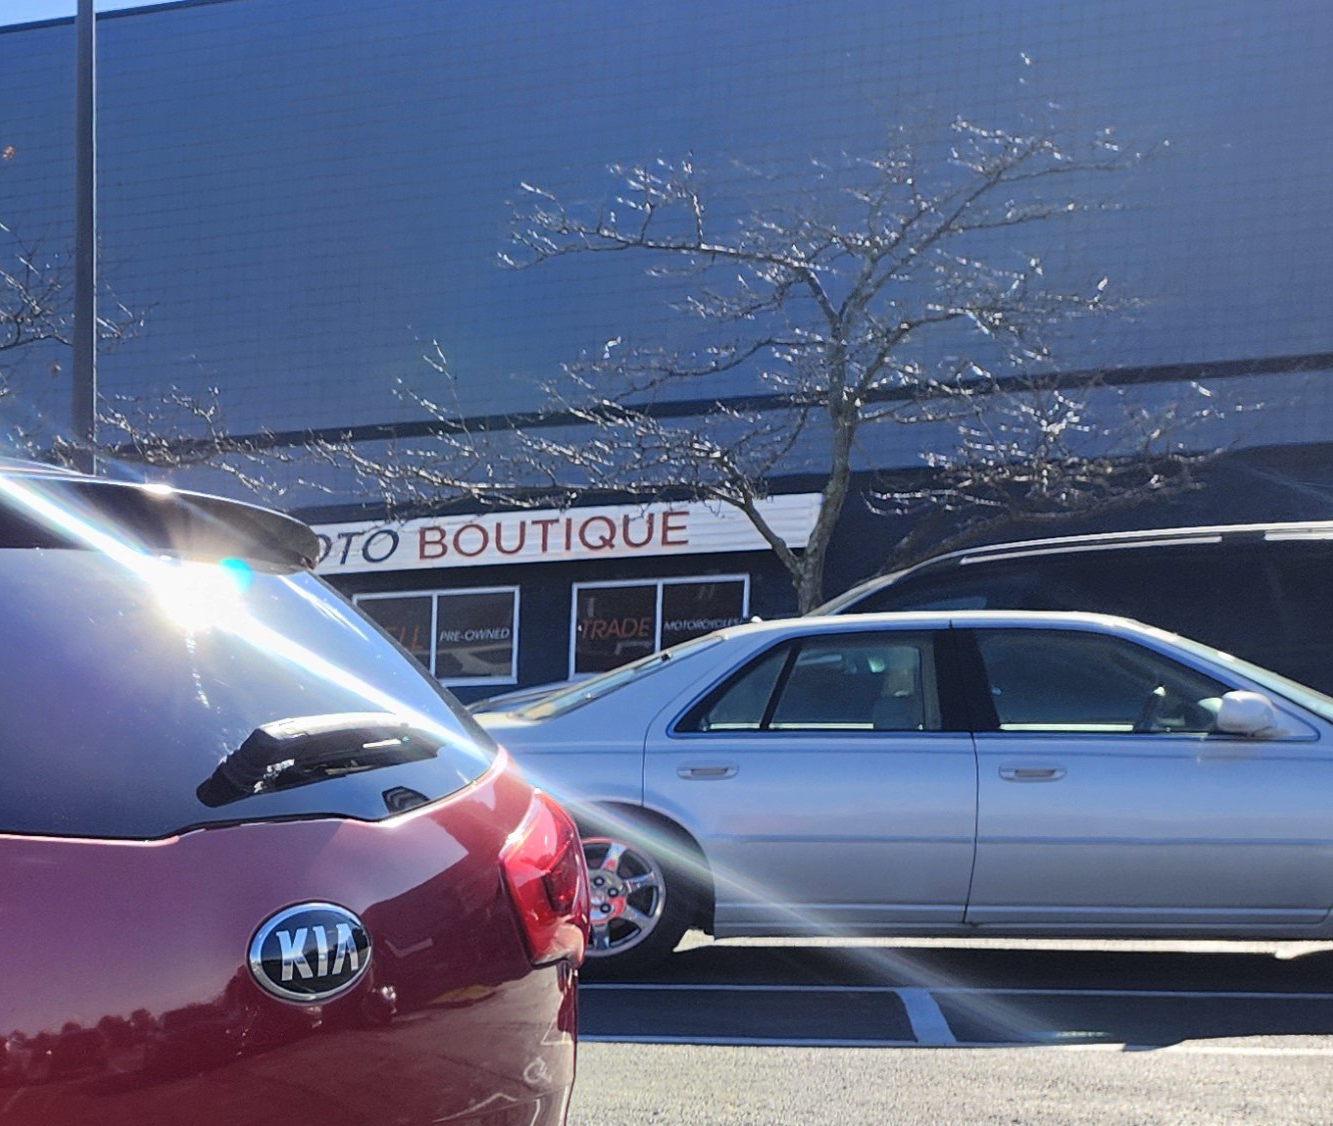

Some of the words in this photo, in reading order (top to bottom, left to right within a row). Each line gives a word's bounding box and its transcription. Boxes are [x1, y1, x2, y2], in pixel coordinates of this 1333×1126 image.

[419, 510, 690, 561] BOUTIQUE
[439, 628, 511, 642] PRE-OWNED
[581, 617, 652, 640] TRADE
[275, 923, 359, 981] KIA
